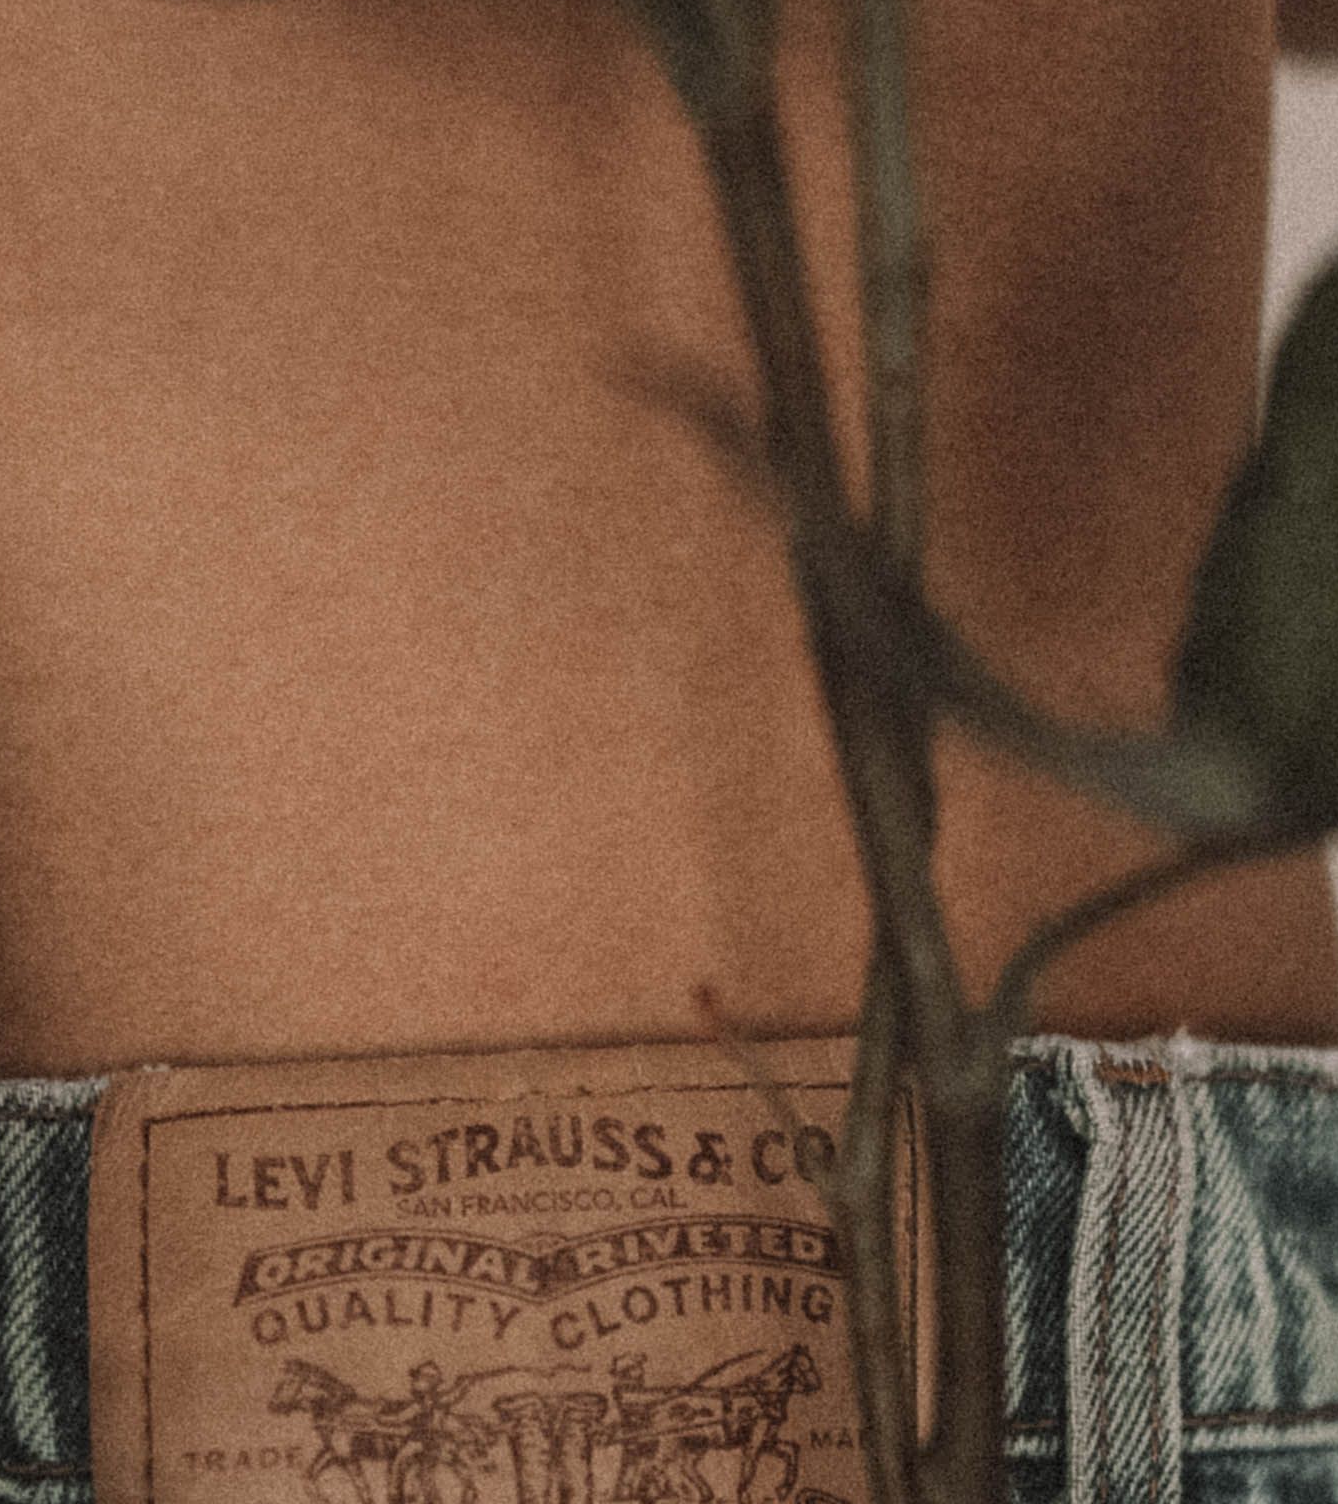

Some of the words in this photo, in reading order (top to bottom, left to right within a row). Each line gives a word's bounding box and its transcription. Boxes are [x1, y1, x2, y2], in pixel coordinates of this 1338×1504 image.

[215, 1149, 358, 1211] LEVI
[387, 1115, 673, 1196] STRAUSS
[688, 1130, 733, 1186] &
[396, 1196, 451, 1217] SAN
[254, 1238, 539, 1292] ORIGINAL
[576, 1222, 826, 1276] RIVETED
[252, 1289, 521, 1346] QUALITY
[549, 1273, 836, 1350] CLOTHING
